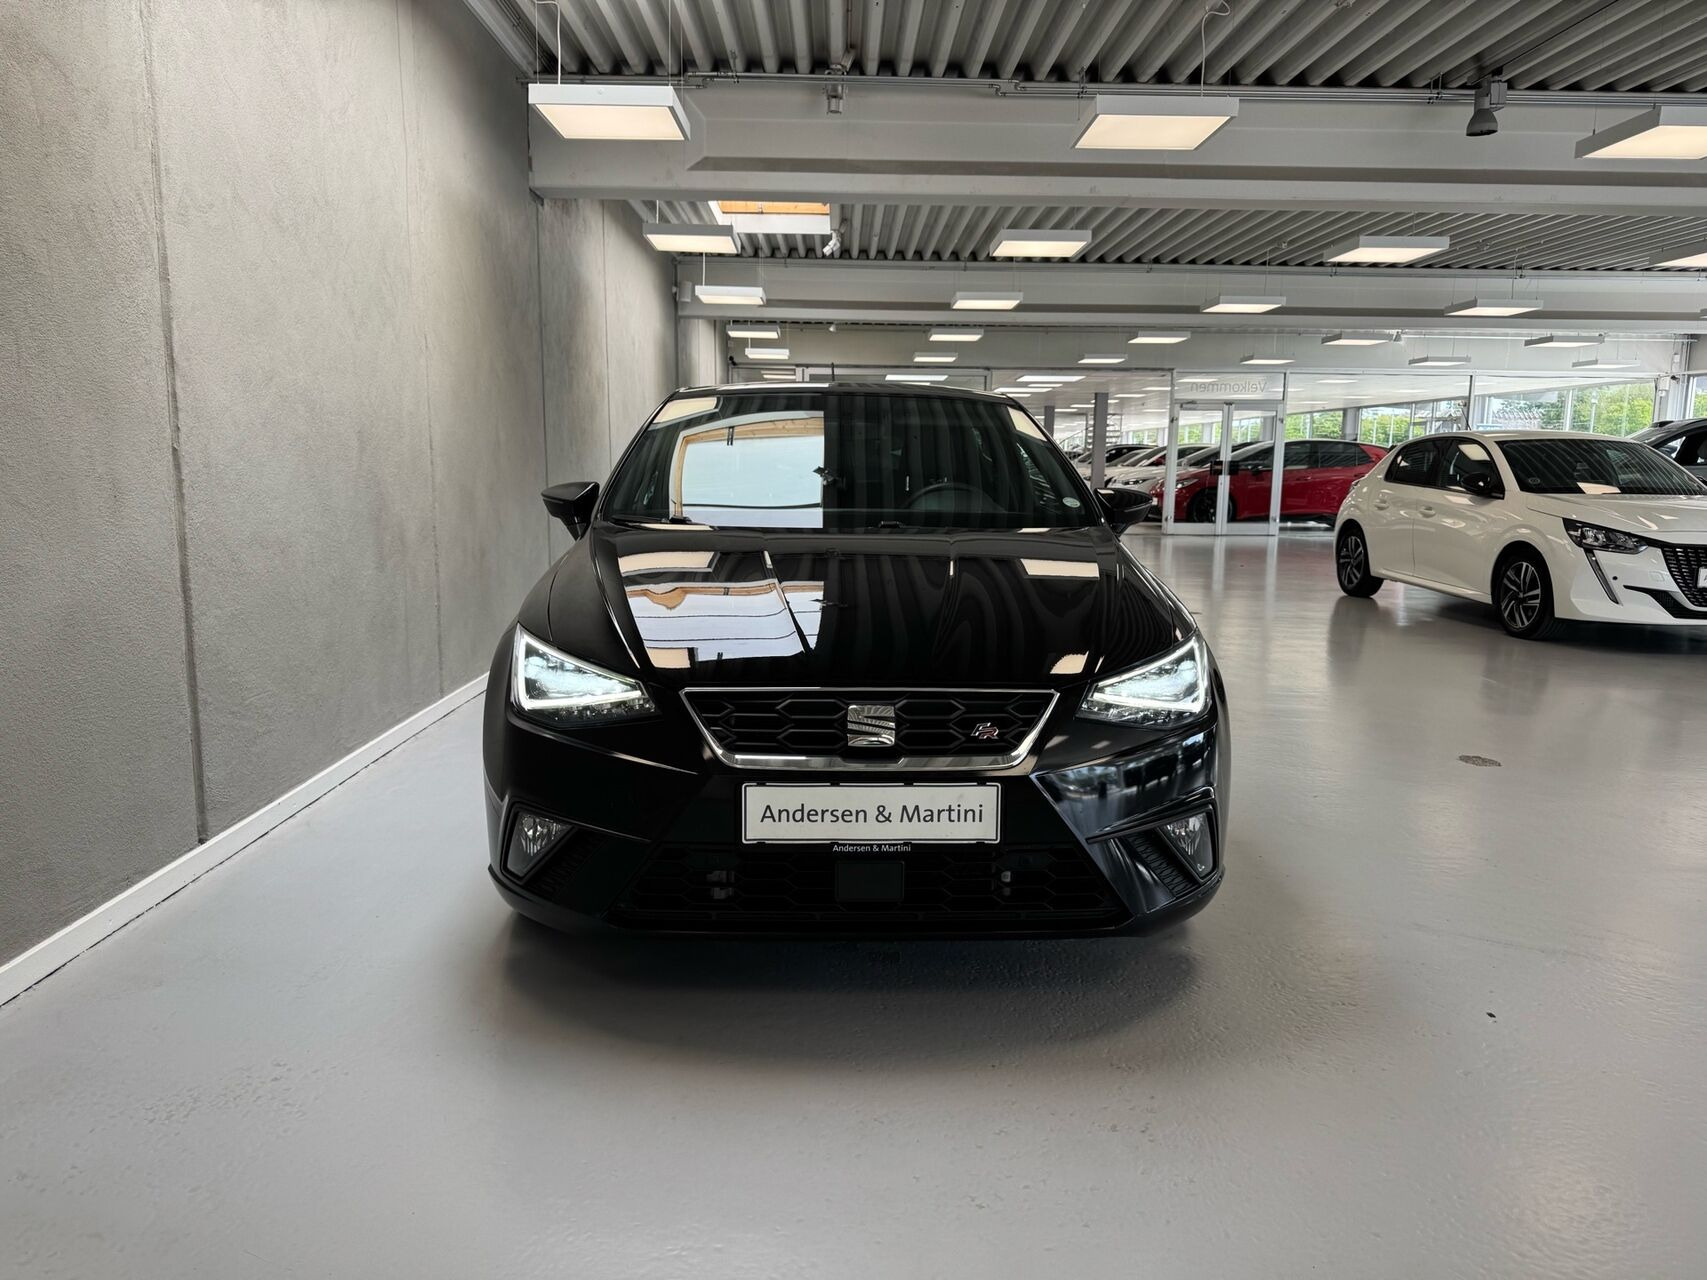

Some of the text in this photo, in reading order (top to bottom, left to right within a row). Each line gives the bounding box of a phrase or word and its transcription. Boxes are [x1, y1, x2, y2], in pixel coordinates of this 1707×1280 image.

[760, 803, 984, 823] Andersen & Martini
[832, 844, 911, 852] Andersen & Martini
